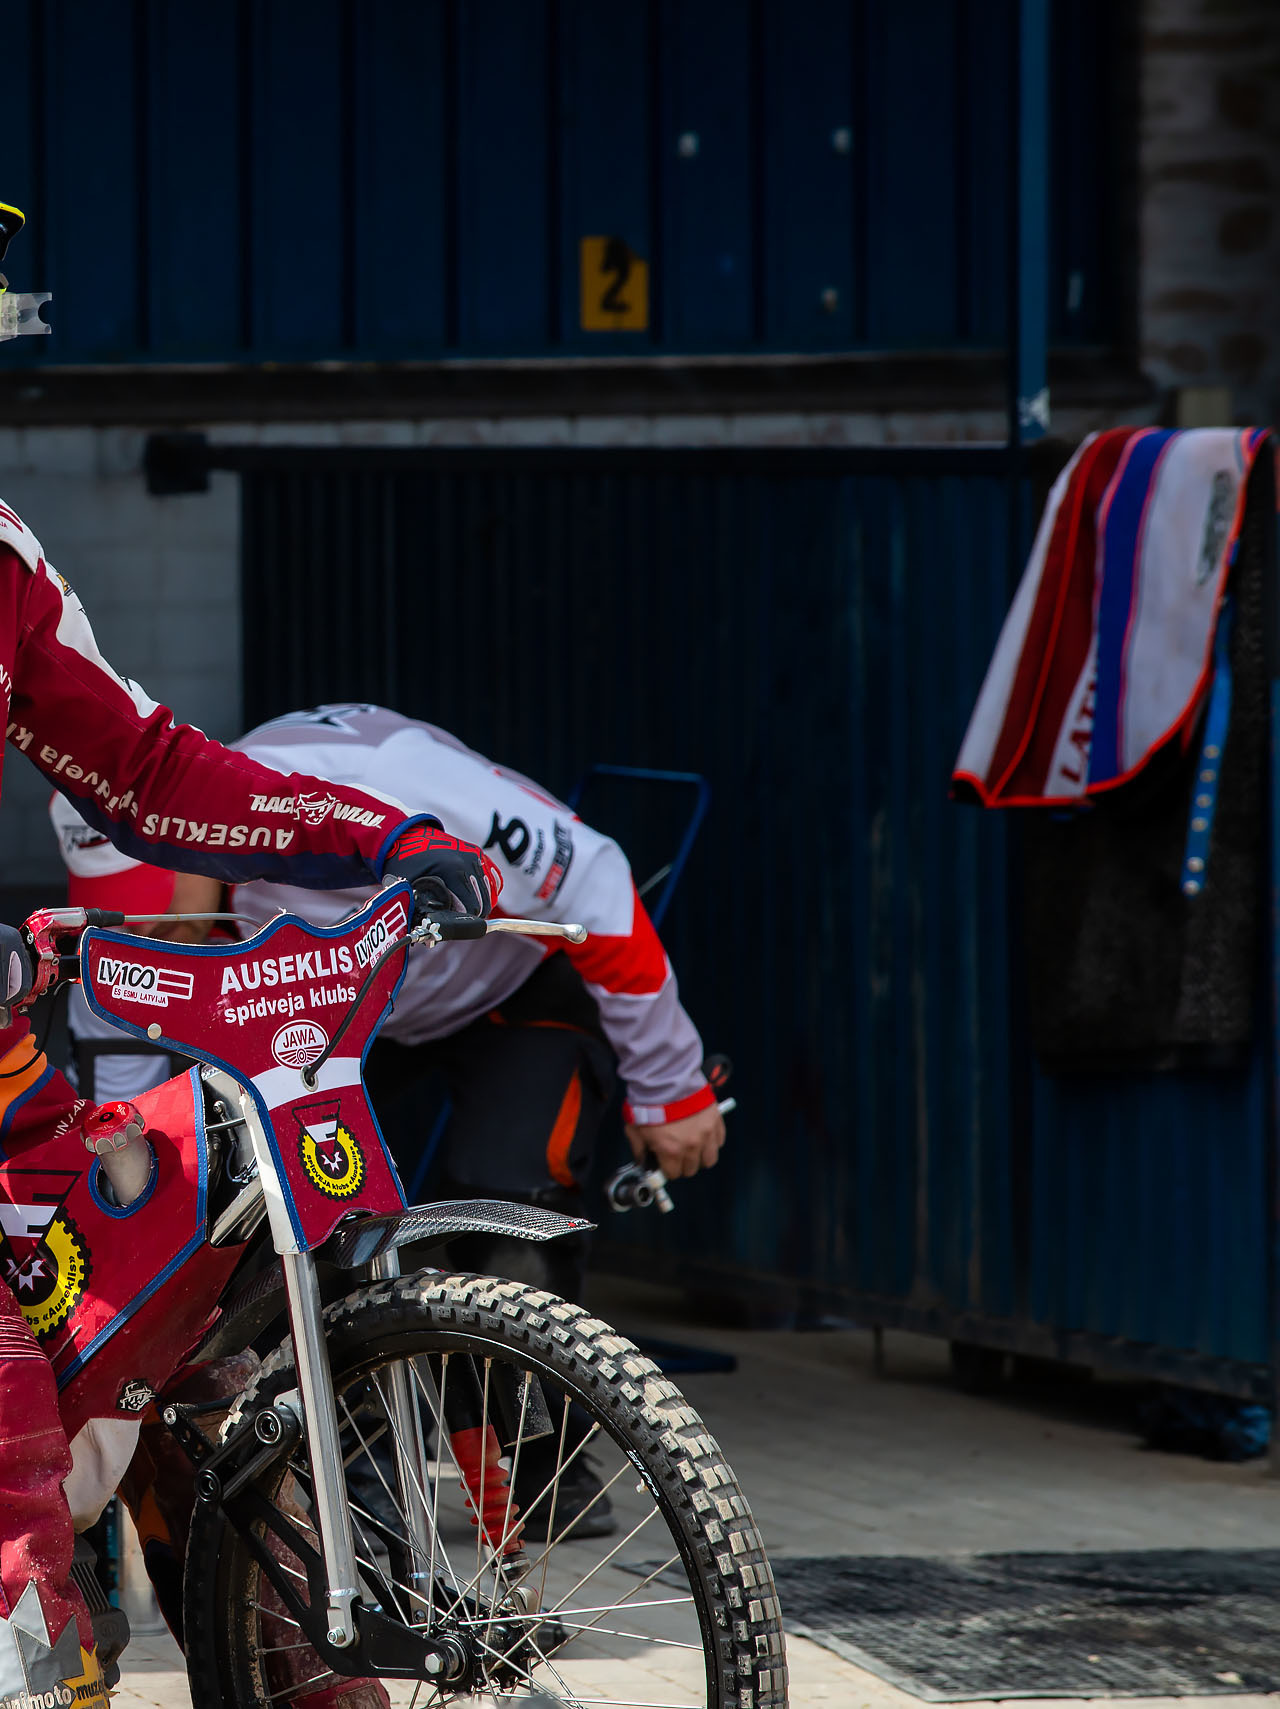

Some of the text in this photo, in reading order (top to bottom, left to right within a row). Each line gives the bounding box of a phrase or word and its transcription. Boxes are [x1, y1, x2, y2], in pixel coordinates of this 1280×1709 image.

[599, 236, 631, 314] 2
[142, 813, 295, 850] AUSEKLIS
[221, 946, 354, 995] AUSEKLIS
[114, 987, 166, 1004] ES ESMU LATVIJA
[224, 984, 357, 1026] spīdveja klubs
[283, 1028, 316, 1048] JAWA
